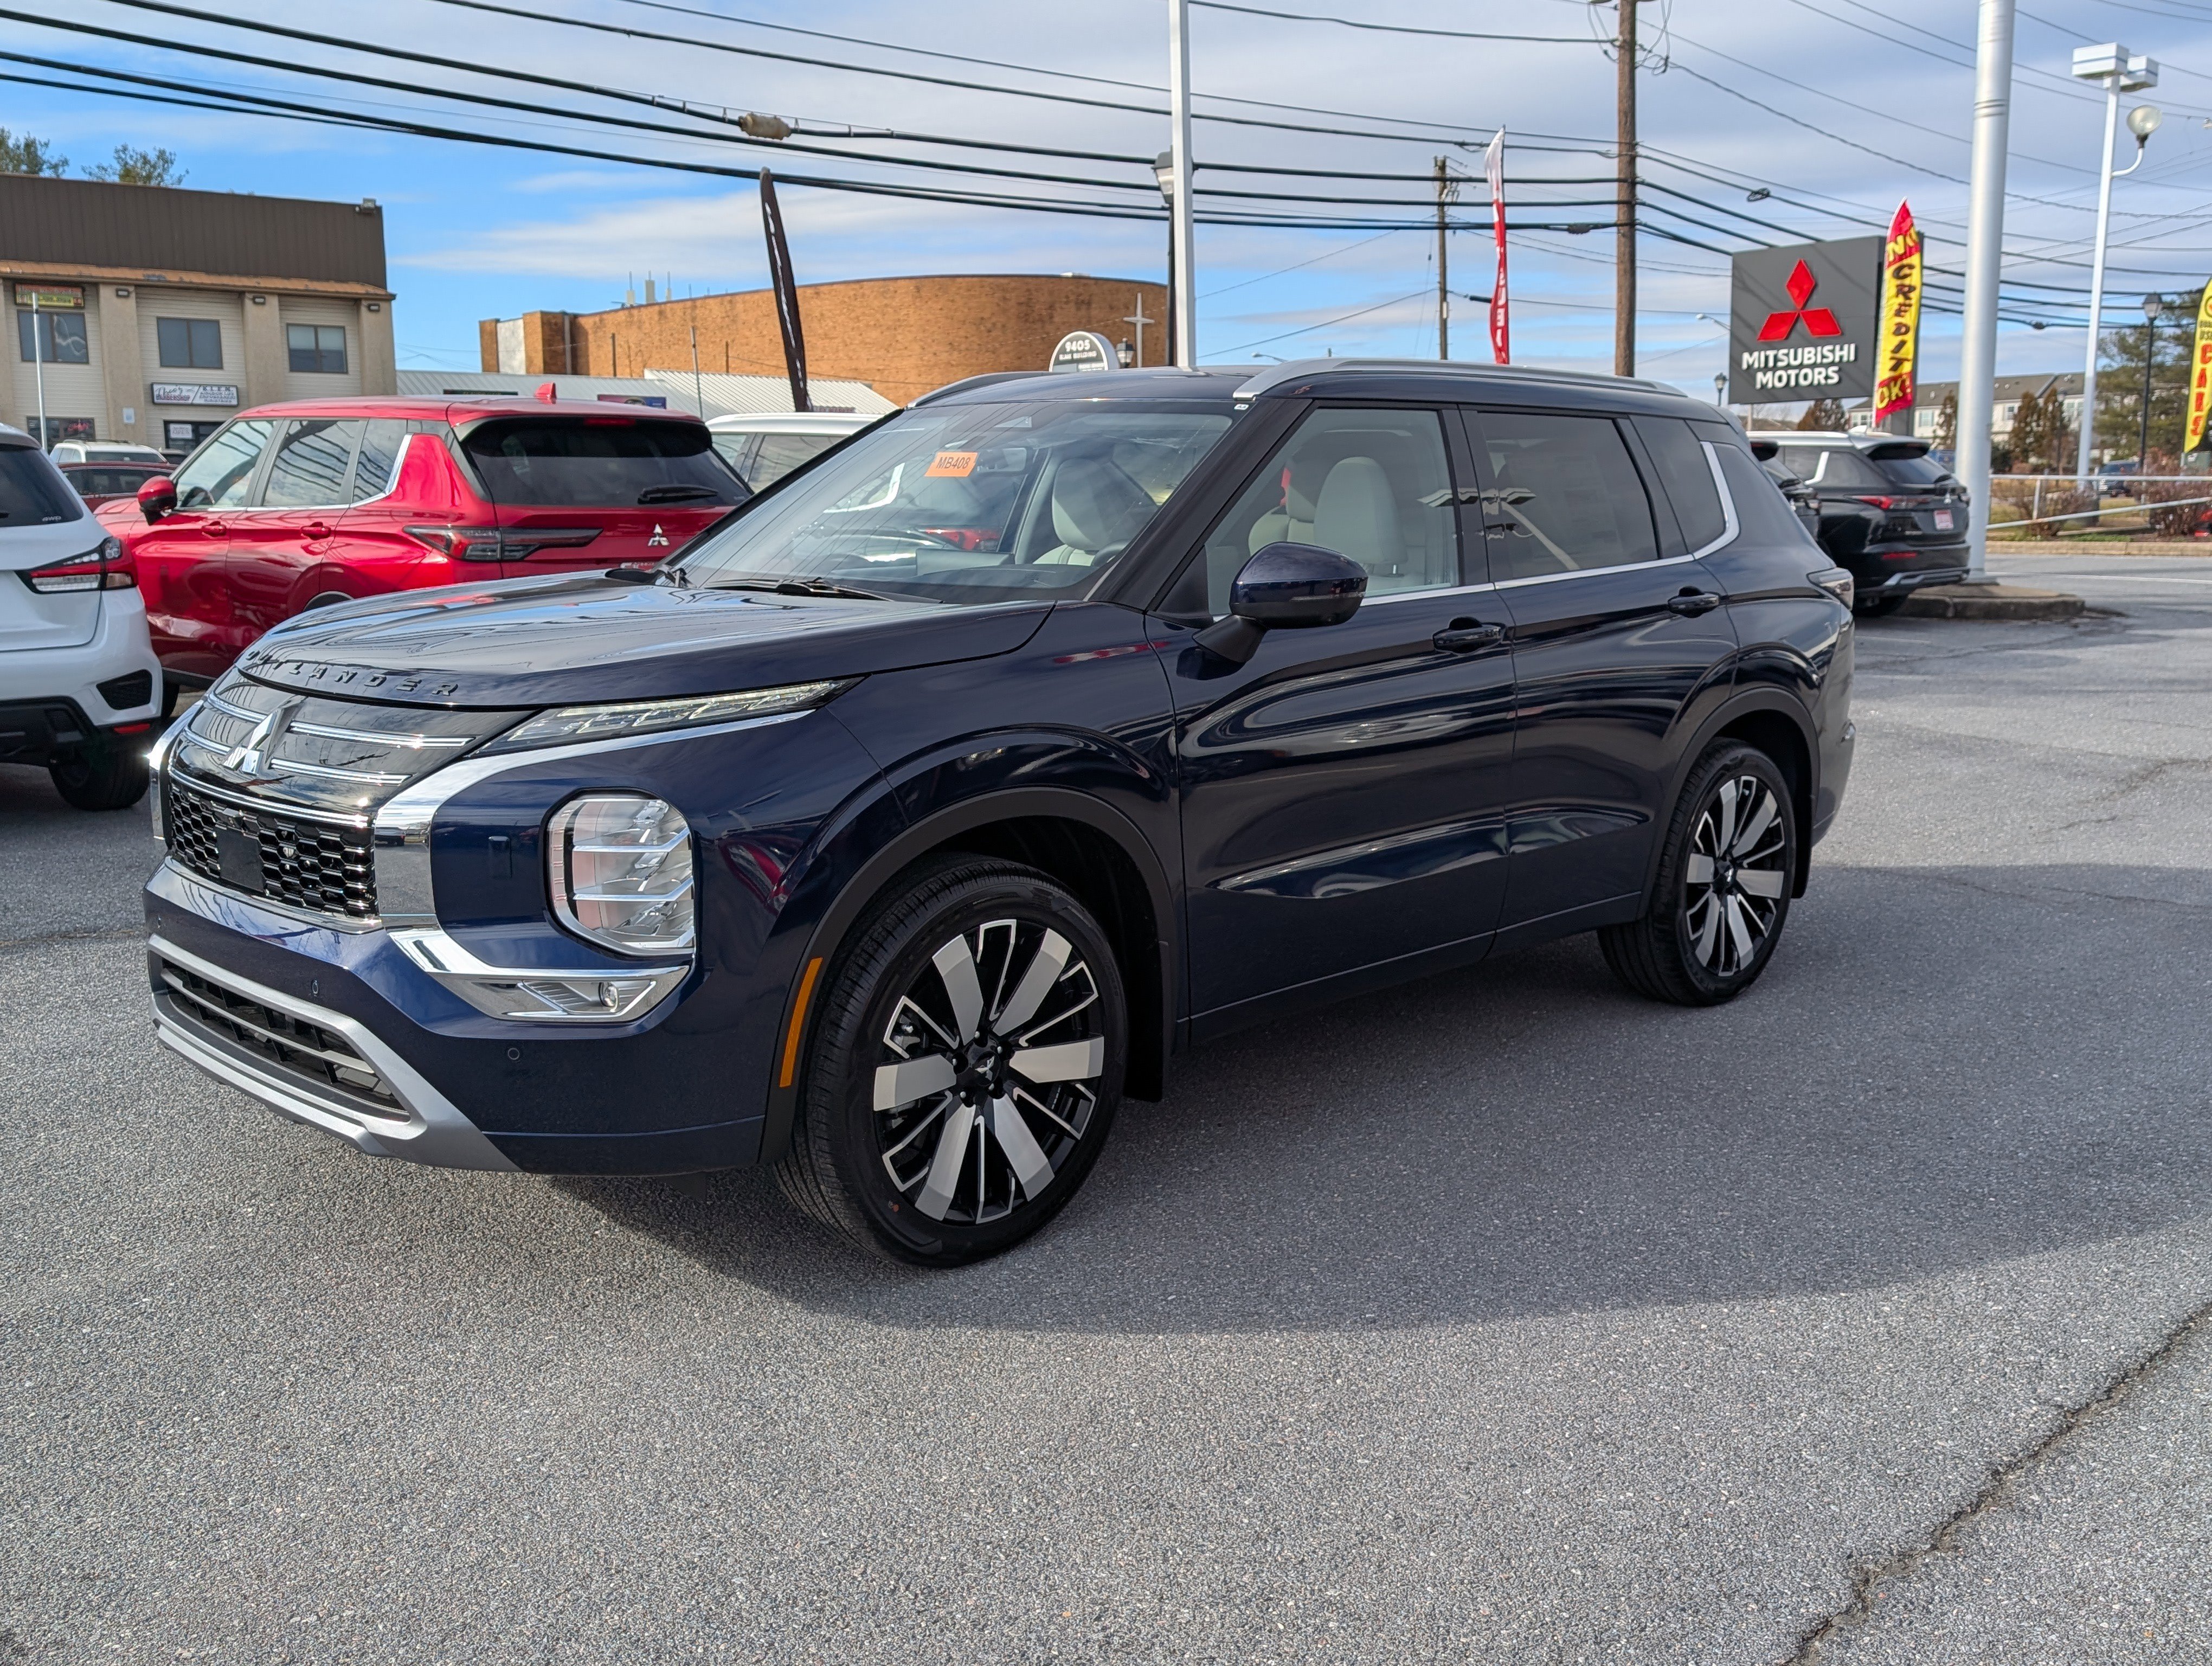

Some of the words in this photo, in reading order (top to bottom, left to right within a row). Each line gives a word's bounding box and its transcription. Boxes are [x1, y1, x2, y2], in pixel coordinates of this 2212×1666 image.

[1889, 264, 1916, 371] CREDIT
[1065, 339, 1091, 352] 9405
[1741, 343, 1856, 370] MITSUBISHI
[1755, 366, 1841, 390] MOTORS
[936, 457, 971, 470] MB408
[245, 650, 459, 696] OUTLANDER
